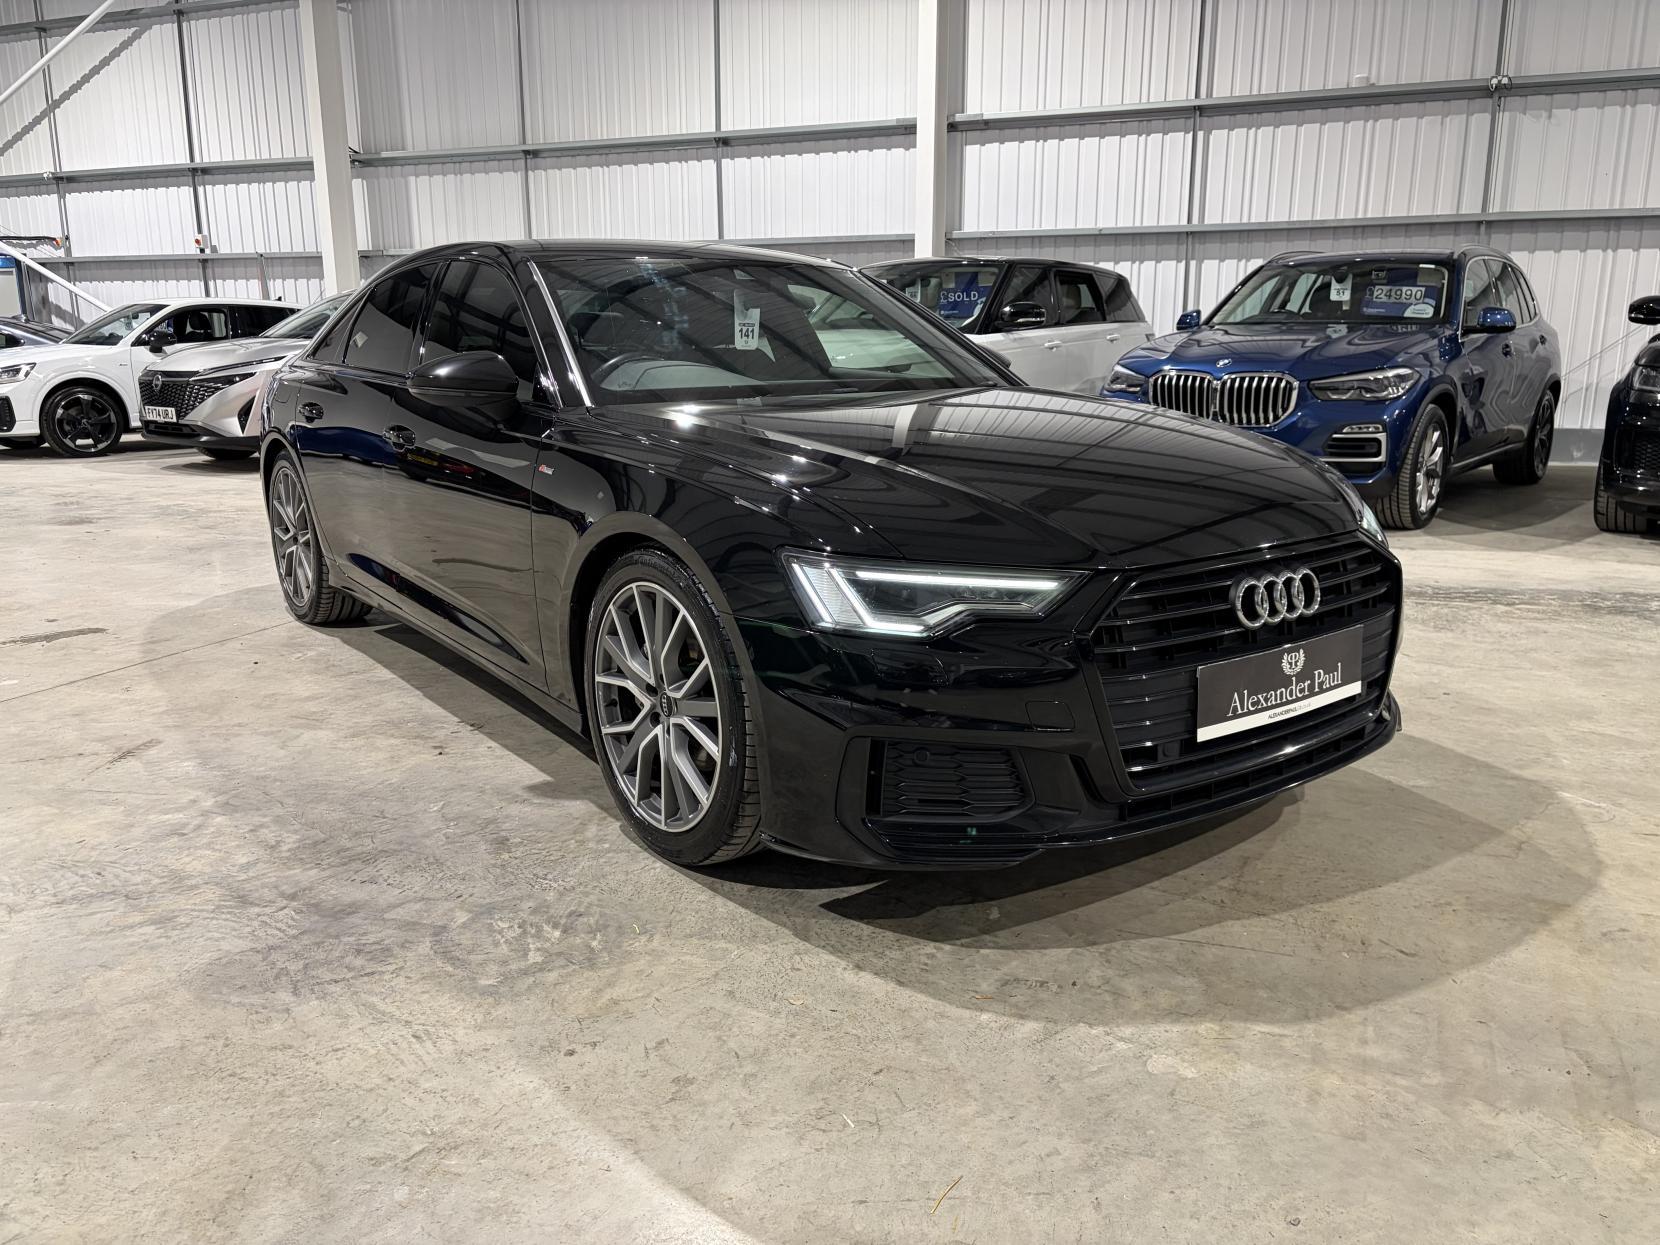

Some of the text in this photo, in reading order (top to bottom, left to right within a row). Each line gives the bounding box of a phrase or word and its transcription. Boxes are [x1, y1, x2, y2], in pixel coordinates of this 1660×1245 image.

[738, 327, 755, 340] 141
[1227, 662, 1342, 717] Alexander Paul
